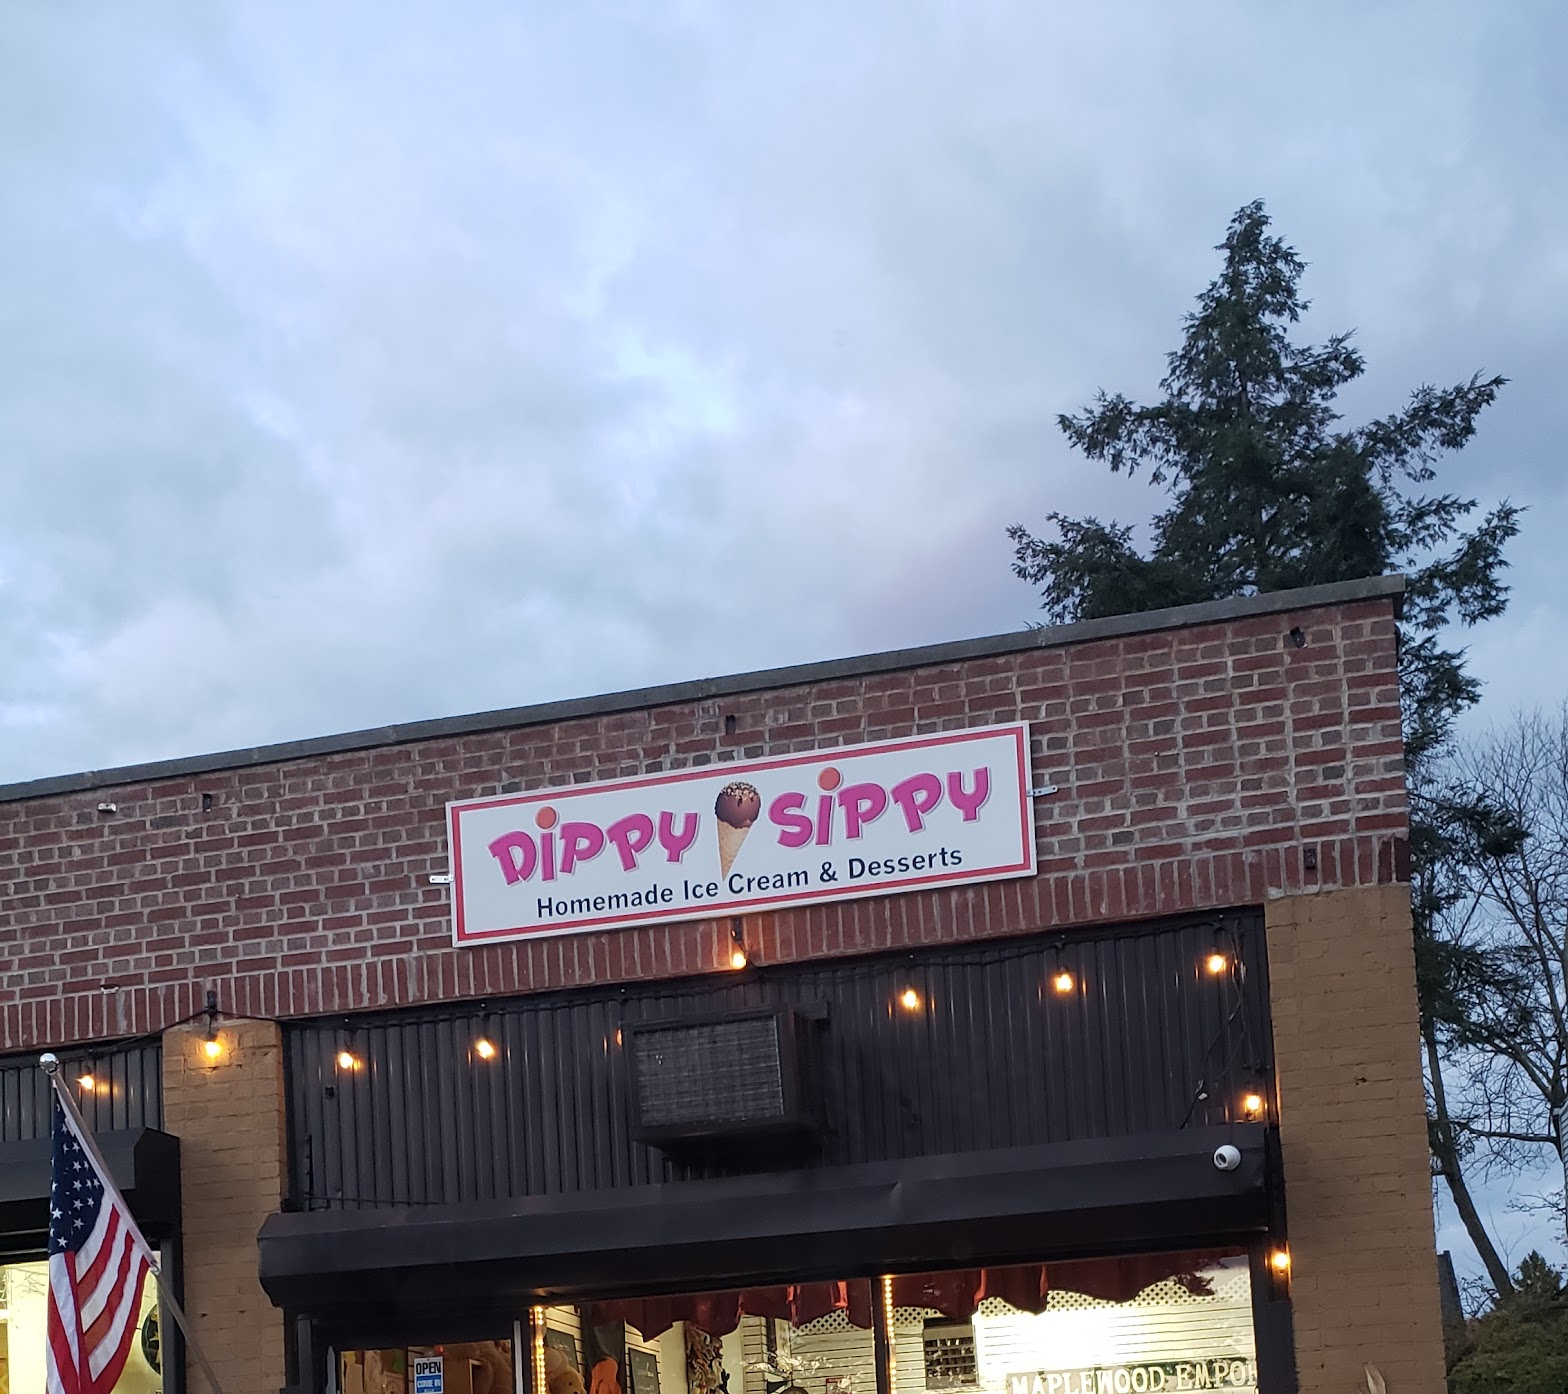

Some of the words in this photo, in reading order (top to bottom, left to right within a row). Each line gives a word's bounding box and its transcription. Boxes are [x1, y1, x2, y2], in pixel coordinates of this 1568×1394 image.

[536, 882, 674, 918] Homemade
[683, 878, 719, 901] Ice
[728, 866, 809, 895] Cream
[818, 861, 839, 883] &
[849, 845, 963, 880] Desserts
[416, 1361, 441, 1375] OPEN
